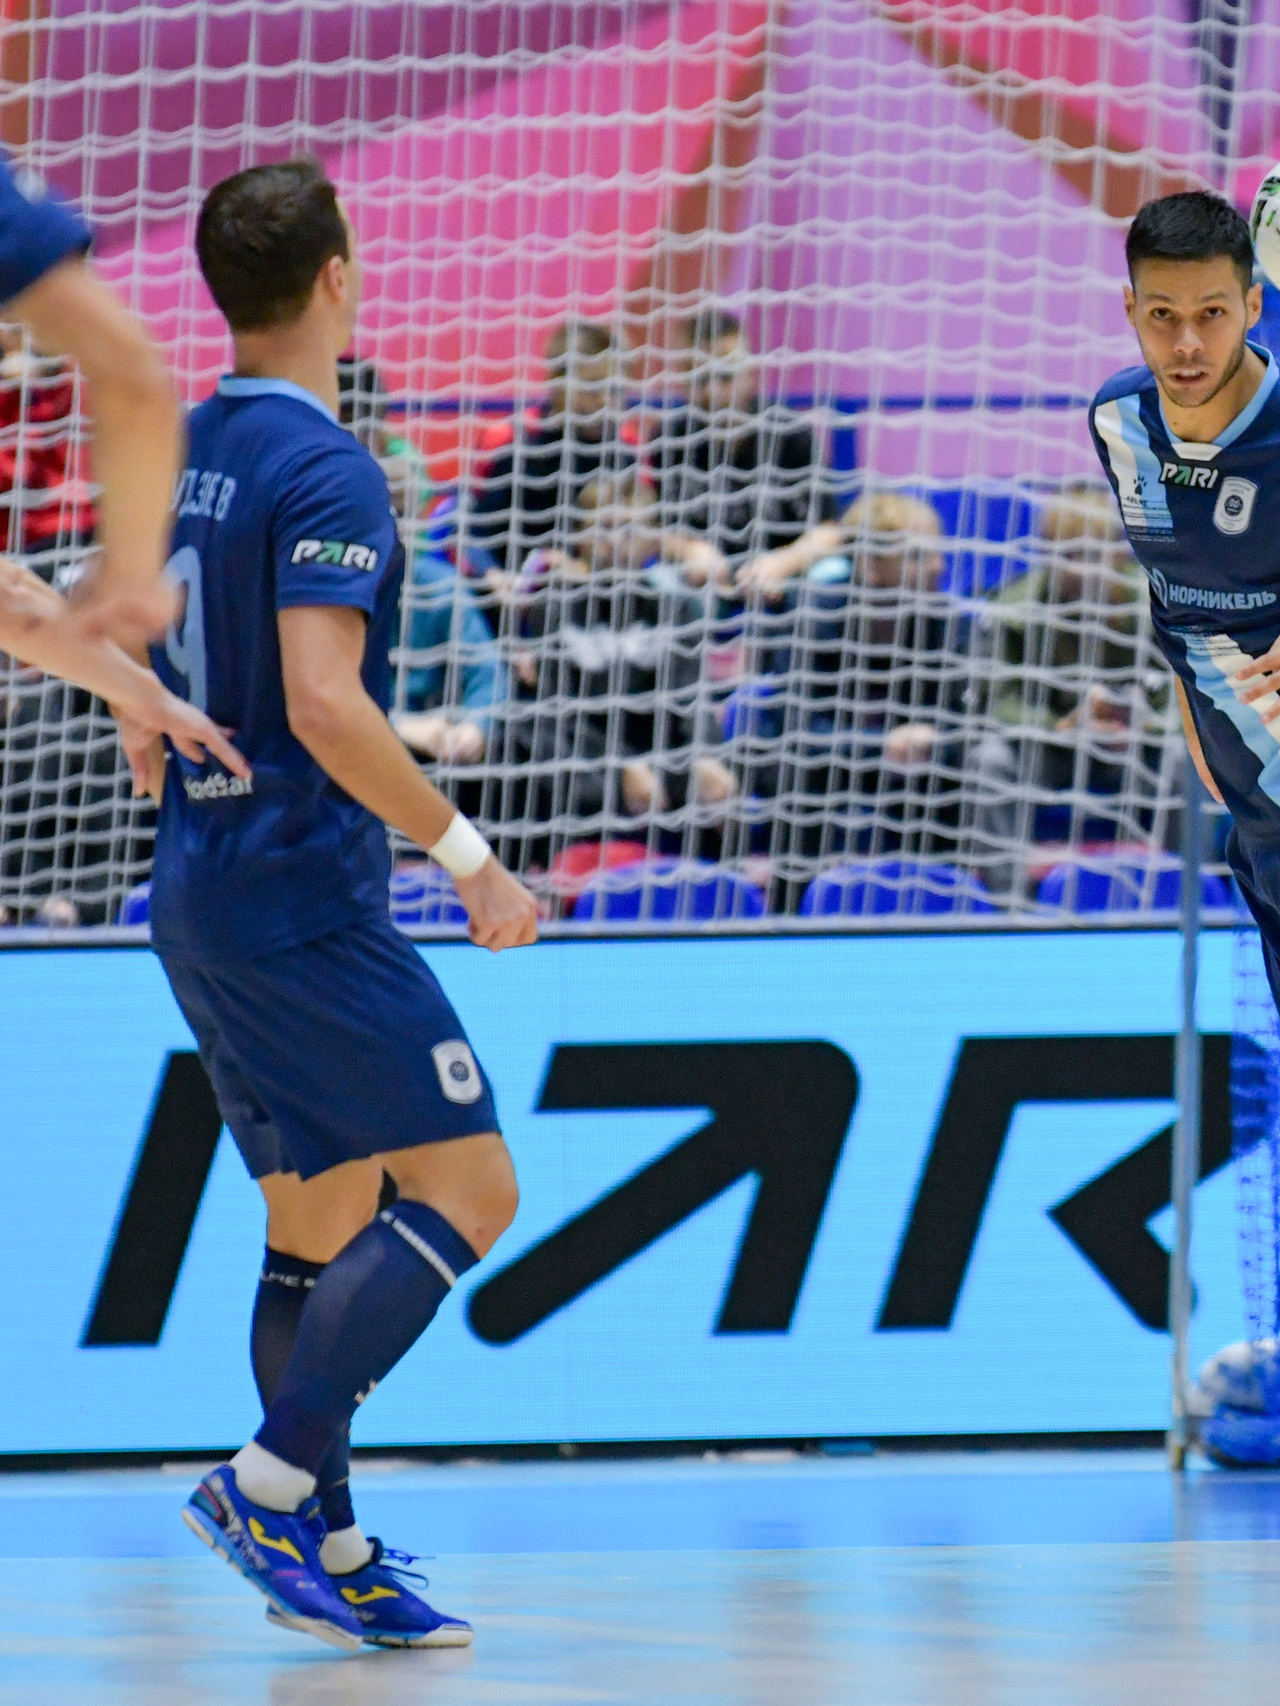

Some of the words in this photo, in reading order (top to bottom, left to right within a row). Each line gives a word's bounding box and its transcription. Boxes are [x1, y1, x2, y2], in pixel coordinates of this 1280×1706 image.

[1160, 462, 1218, 488] PARI
[290, 539, 379, 572] PARI
[1169, 583, 1277, 610] НОРНИКЕЛЬ
